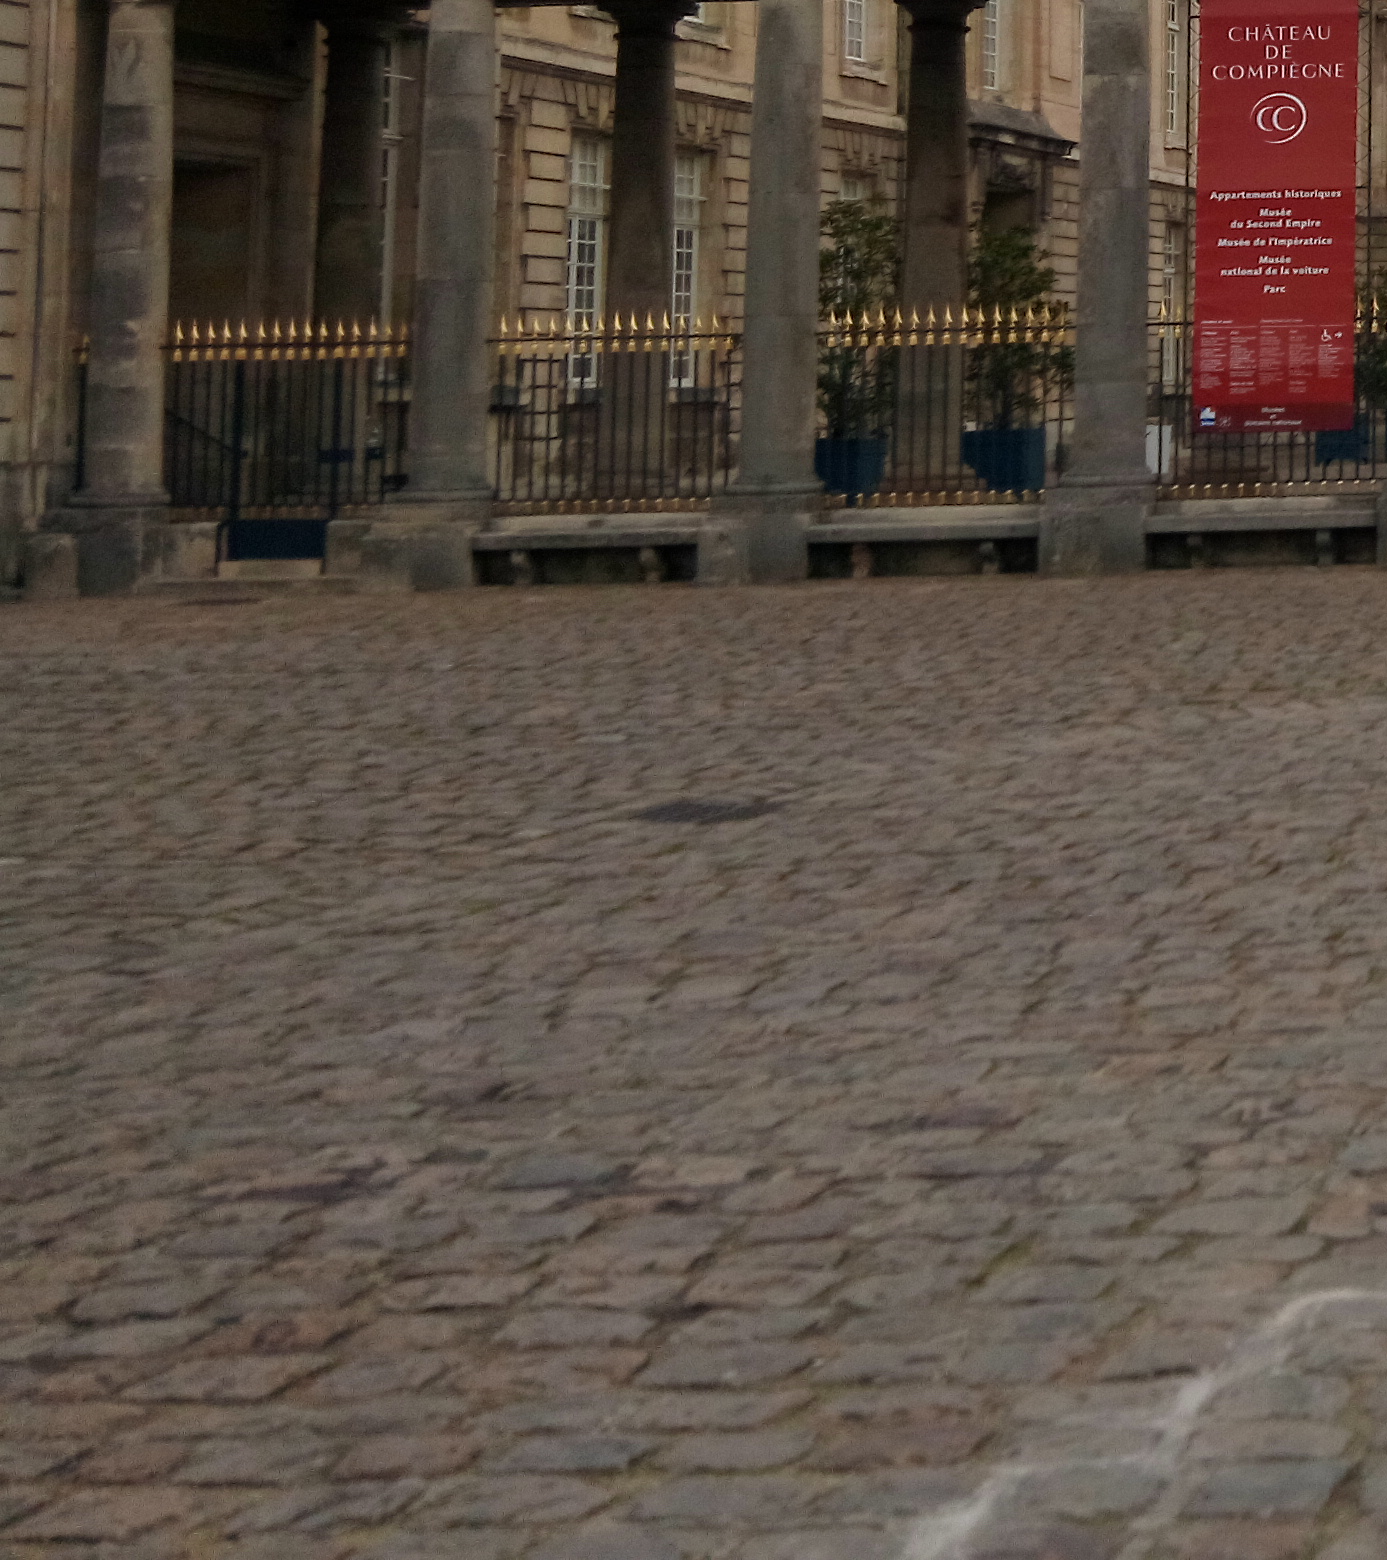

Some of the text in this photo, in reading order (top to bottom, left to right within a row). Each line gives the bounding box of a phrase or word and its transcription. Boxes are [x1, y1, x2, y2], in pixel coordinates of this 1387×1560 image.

[1228, 24, 1331, 42] CHÂTEAU
[1265, 44, 1293, 60] DE
[1212, 62, 1345, 80] COMPIÈGNE
[1210, 189, 1342, 201] Appartements historiques
[1259, 208, 1292, 216] Musée
[1230, 219, 1321, 229] du Second Empire
[1217, 238, 1251, 247] Musée
[1253, 238, 1266, 246] de
[1259, 255, 1292, 264] Musée
[1220, 266, 1330, 276] national de la voiture
[1263, 285, 1286, 293] Parc
